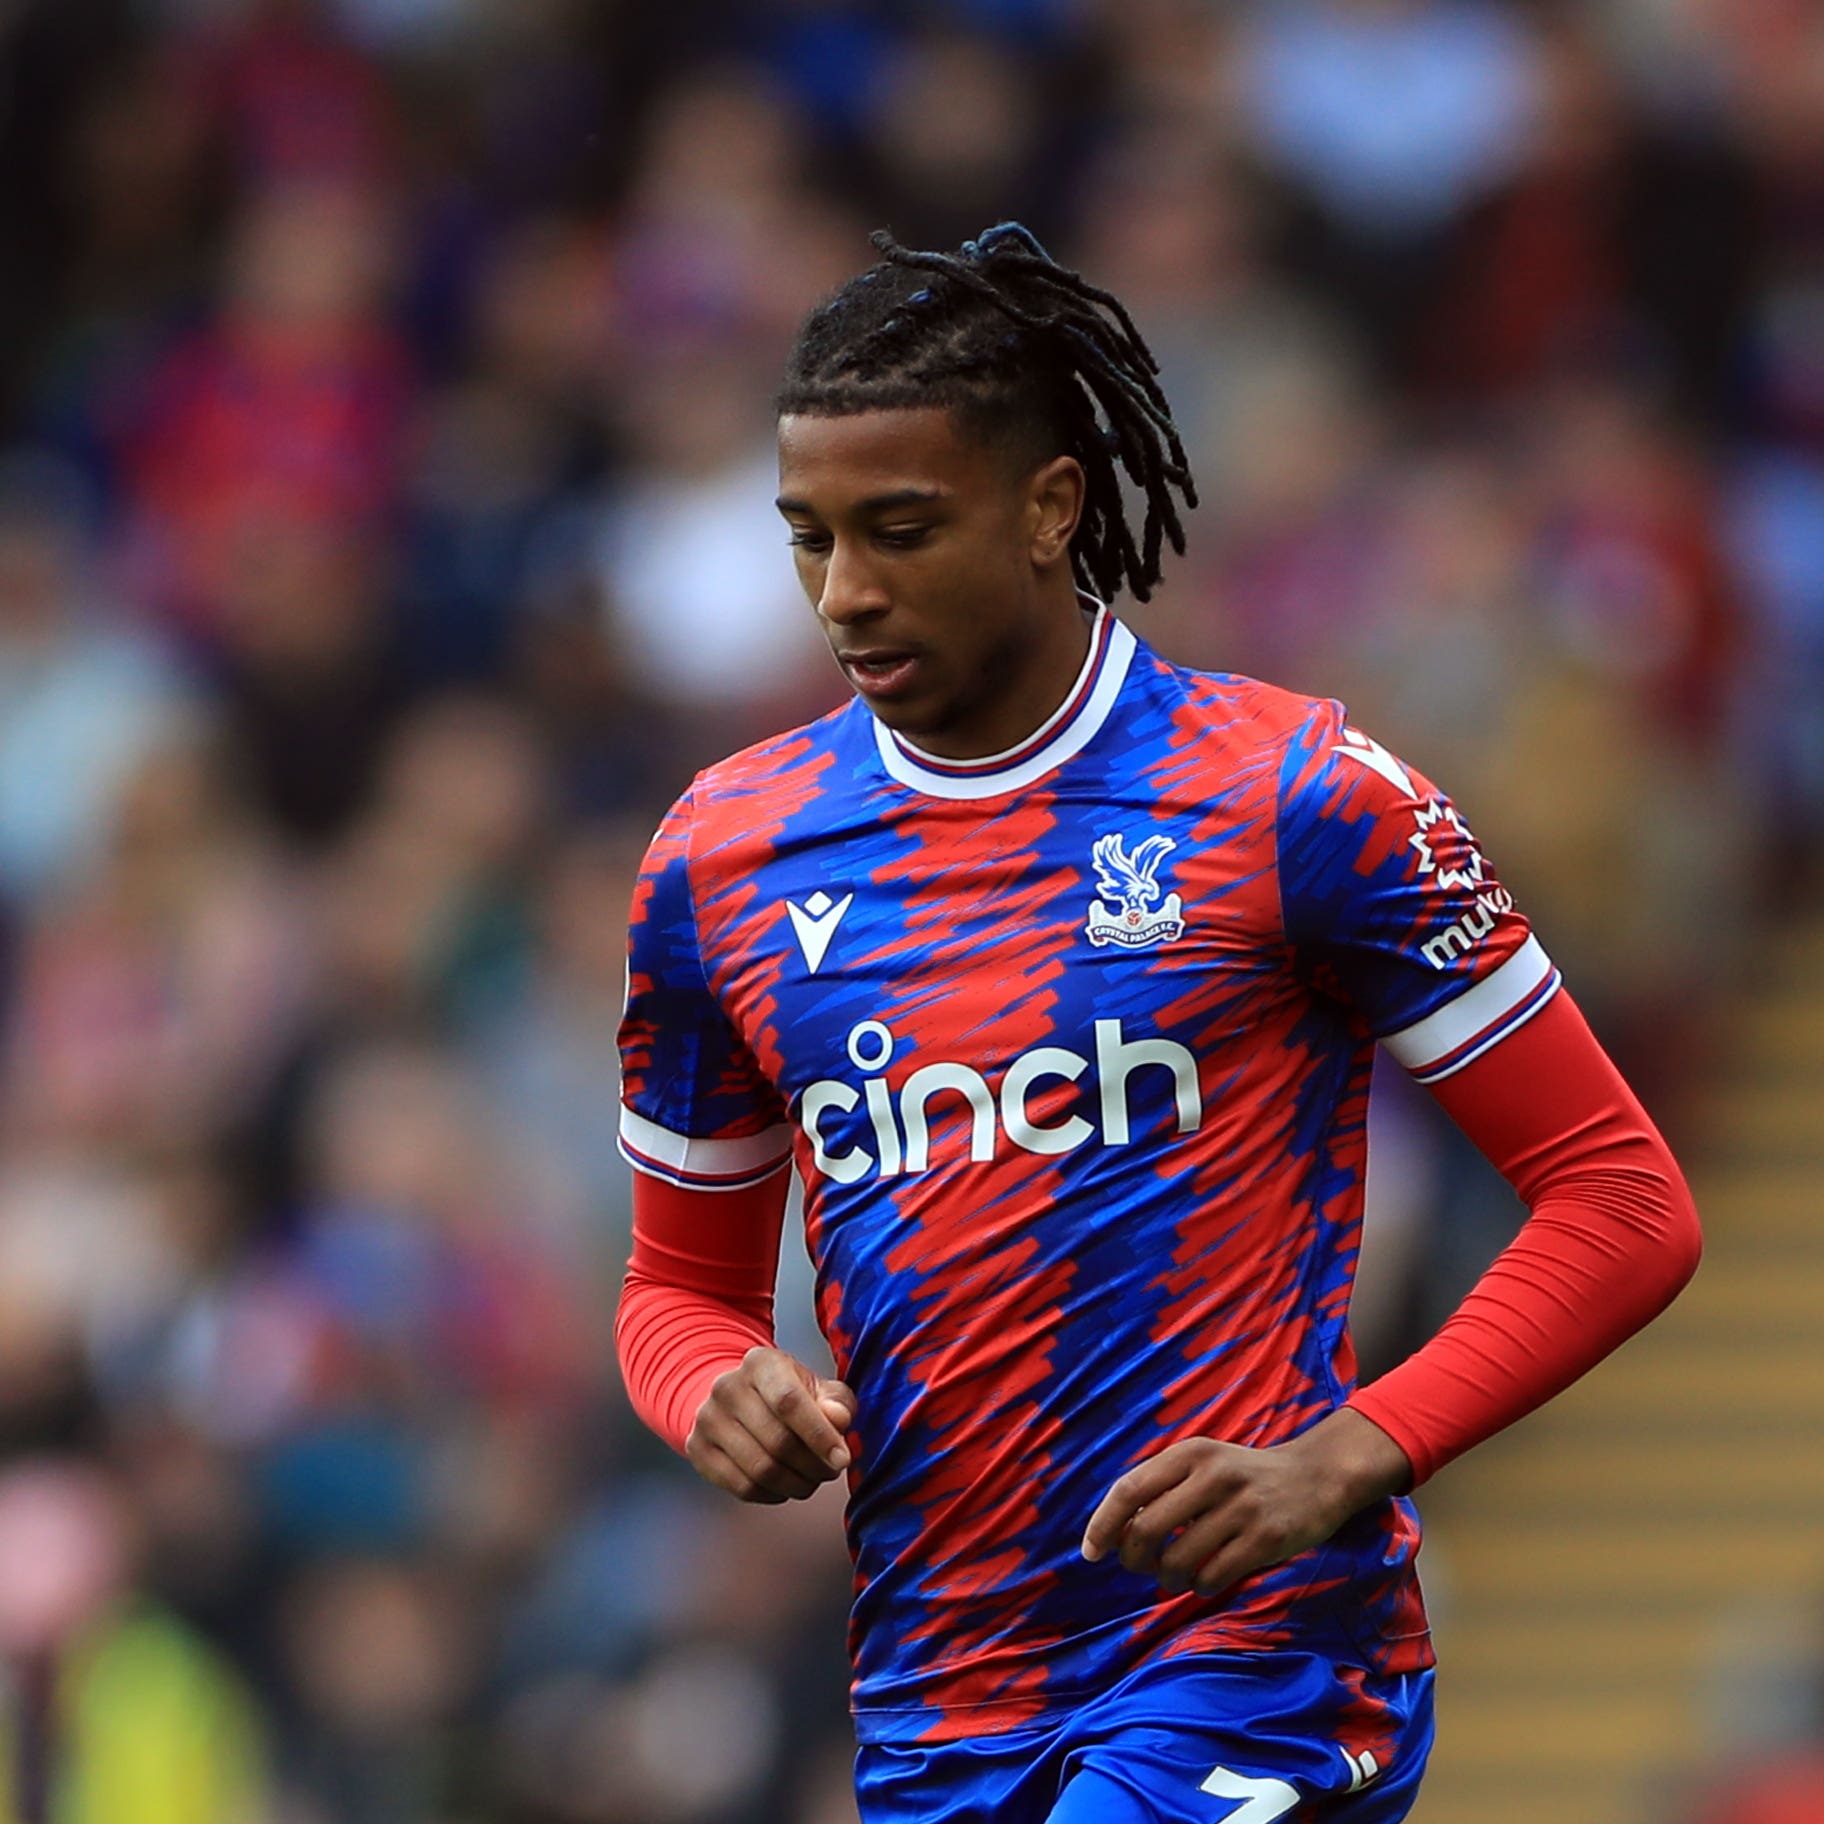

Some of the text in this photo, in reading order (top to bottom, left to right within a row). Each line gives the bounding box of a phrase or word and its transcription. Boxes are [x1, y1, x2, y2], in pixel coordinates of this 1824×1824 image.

[1094, 926, 1129, 943] CRYSTAL
[1129, 926, 1161, 943] PALACE
[801, 1019, 1202, 1184] cinch
